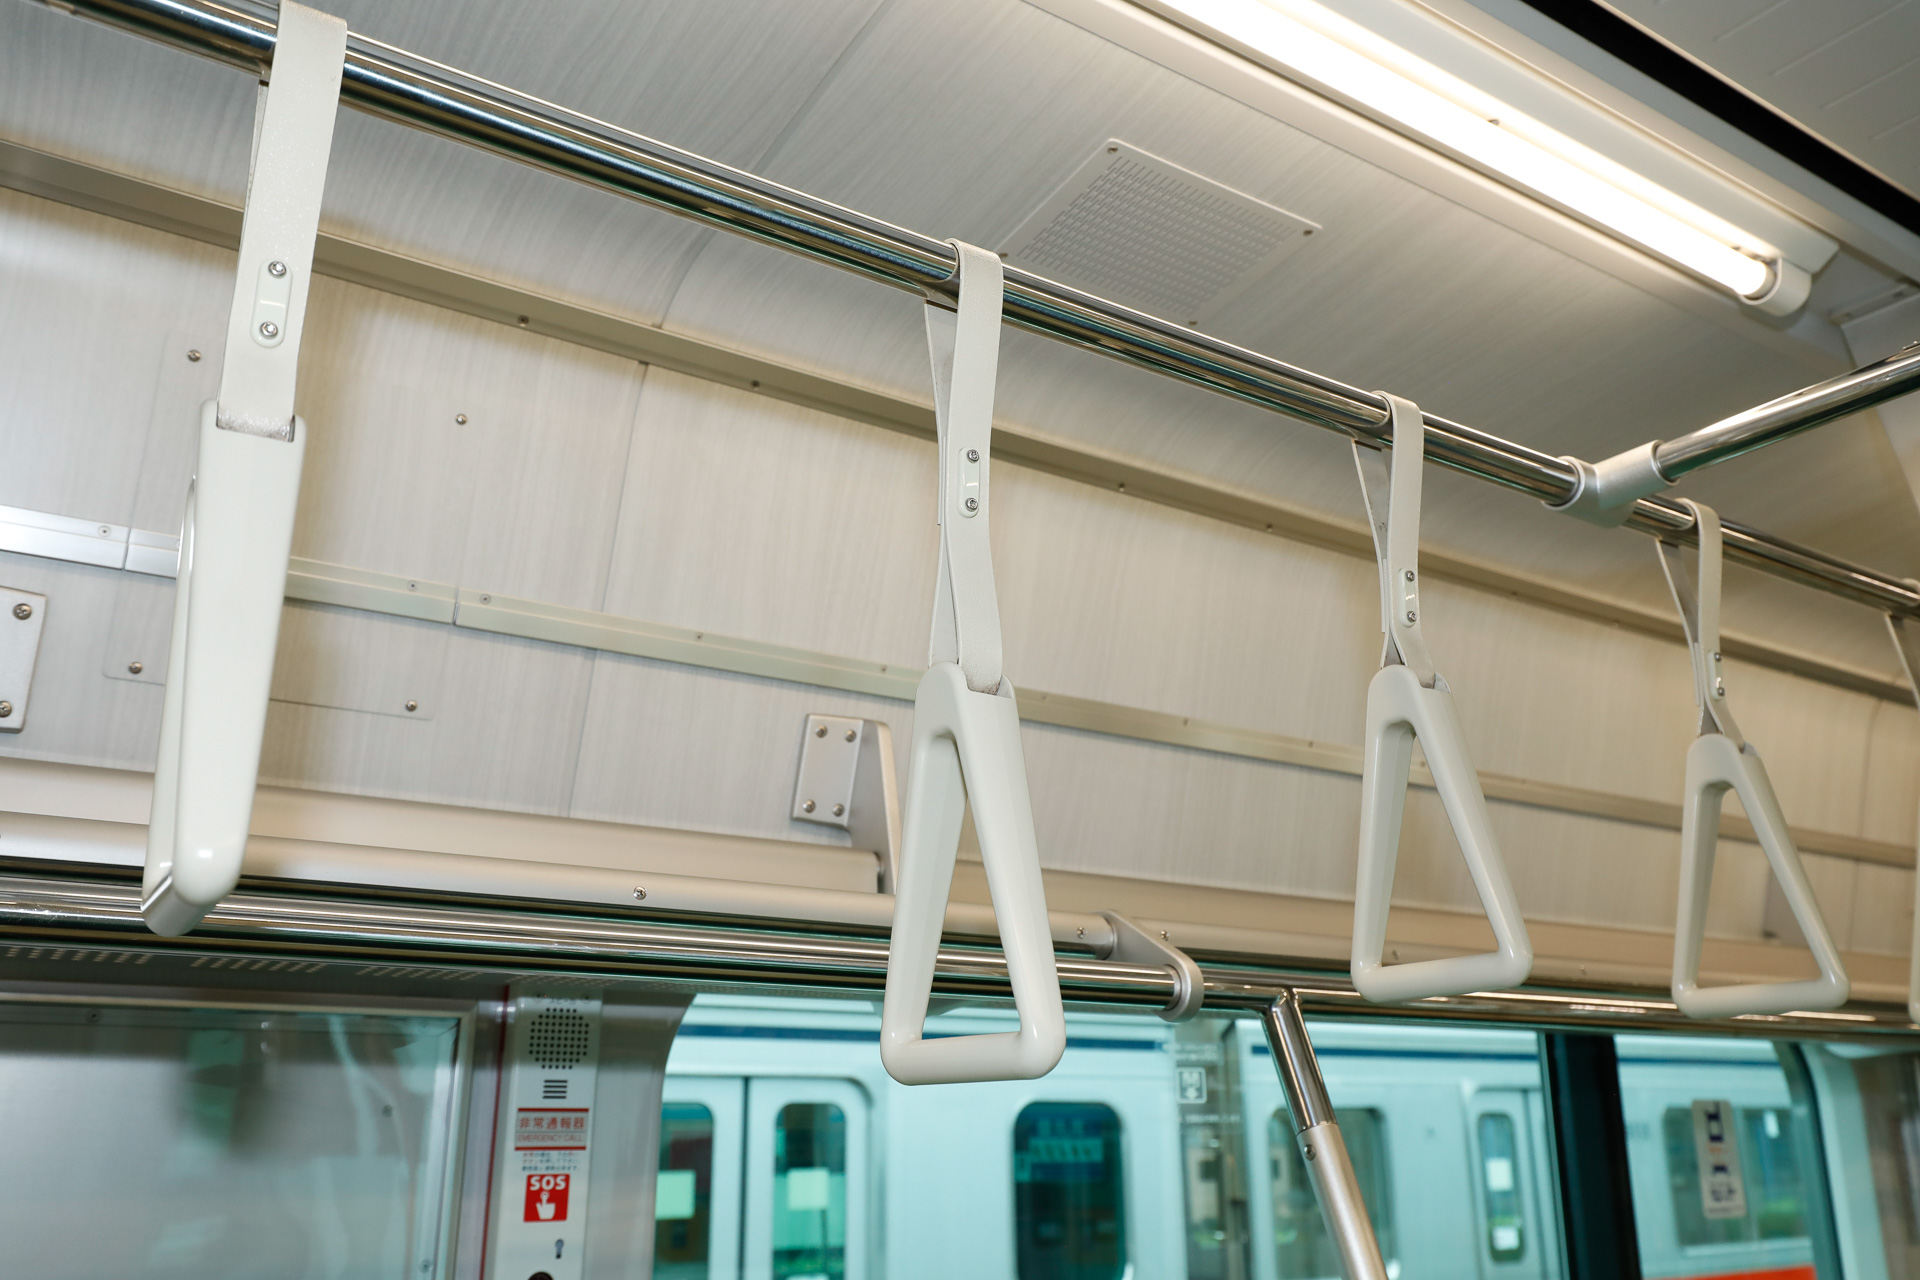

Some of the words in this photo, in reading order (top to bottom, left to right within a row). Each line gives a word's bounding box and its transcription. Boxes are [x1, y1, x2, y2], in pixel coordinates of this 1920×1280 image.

[520, 1117, 585, 1129] 非常通報器
[530, 1176, 566, 1191] SOS
